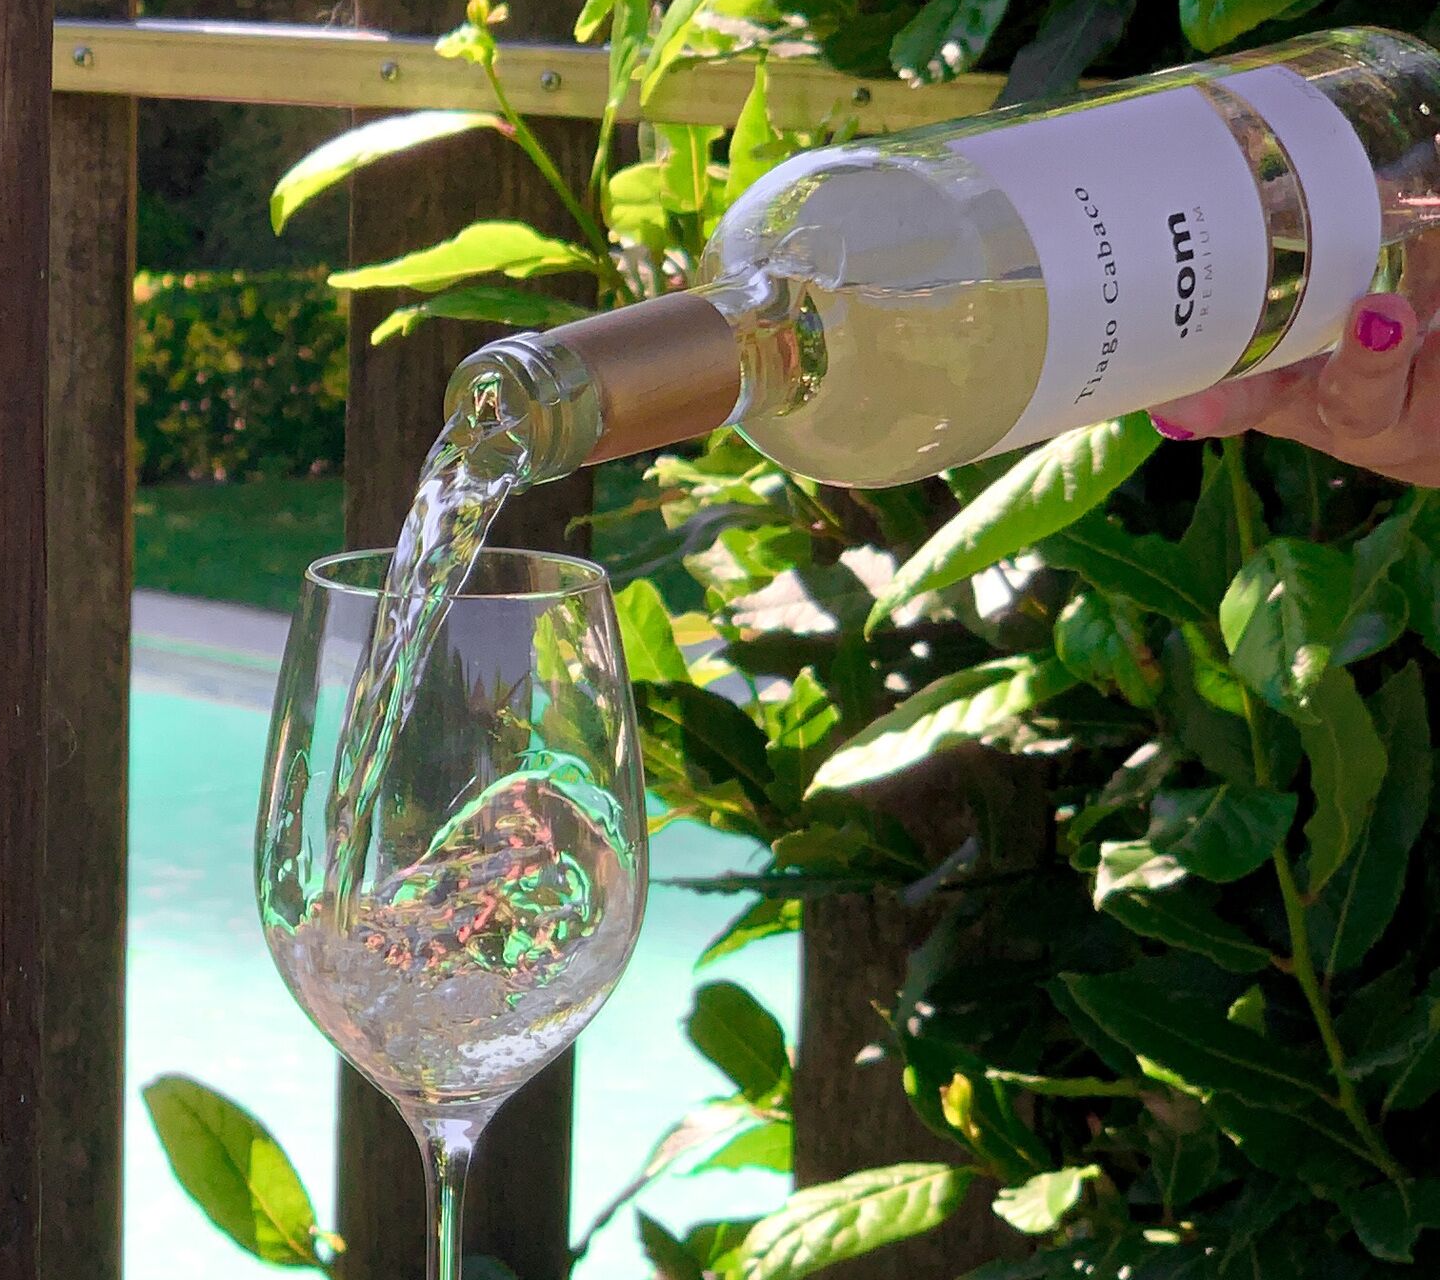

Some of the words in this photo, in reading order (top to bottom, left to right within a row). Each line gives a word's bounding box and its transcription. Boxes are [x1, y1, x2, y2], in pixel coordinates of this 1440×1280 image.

[1168, 212, 1196, 338] .com
[1193, 206, 1213, 332] PREMIUM
[1074, 320, 1119, 404] Tiago
